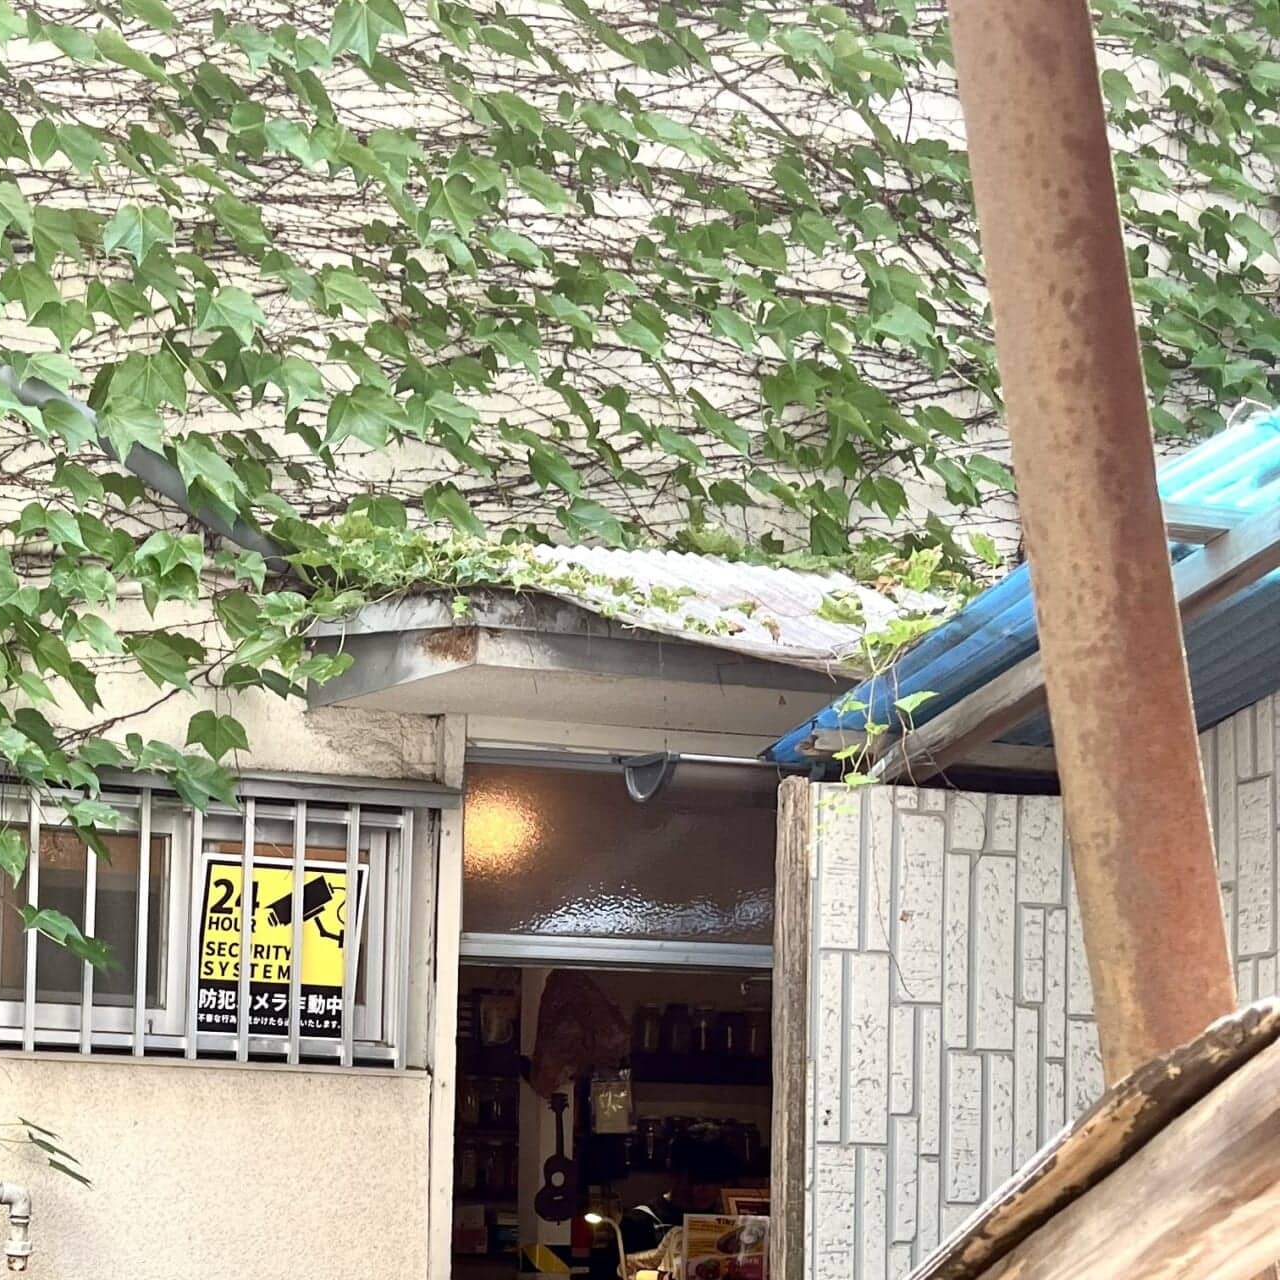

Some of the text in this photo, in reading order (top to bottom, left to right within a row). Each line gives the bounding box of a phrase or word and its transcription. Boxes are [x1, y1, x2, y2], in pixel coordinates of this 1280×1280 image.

[205, 941, 291, 961] SECRITY
[203, 961, 291, 981] SYSTEM
[198, 988, 342, 1016] 防犯メラ動中
